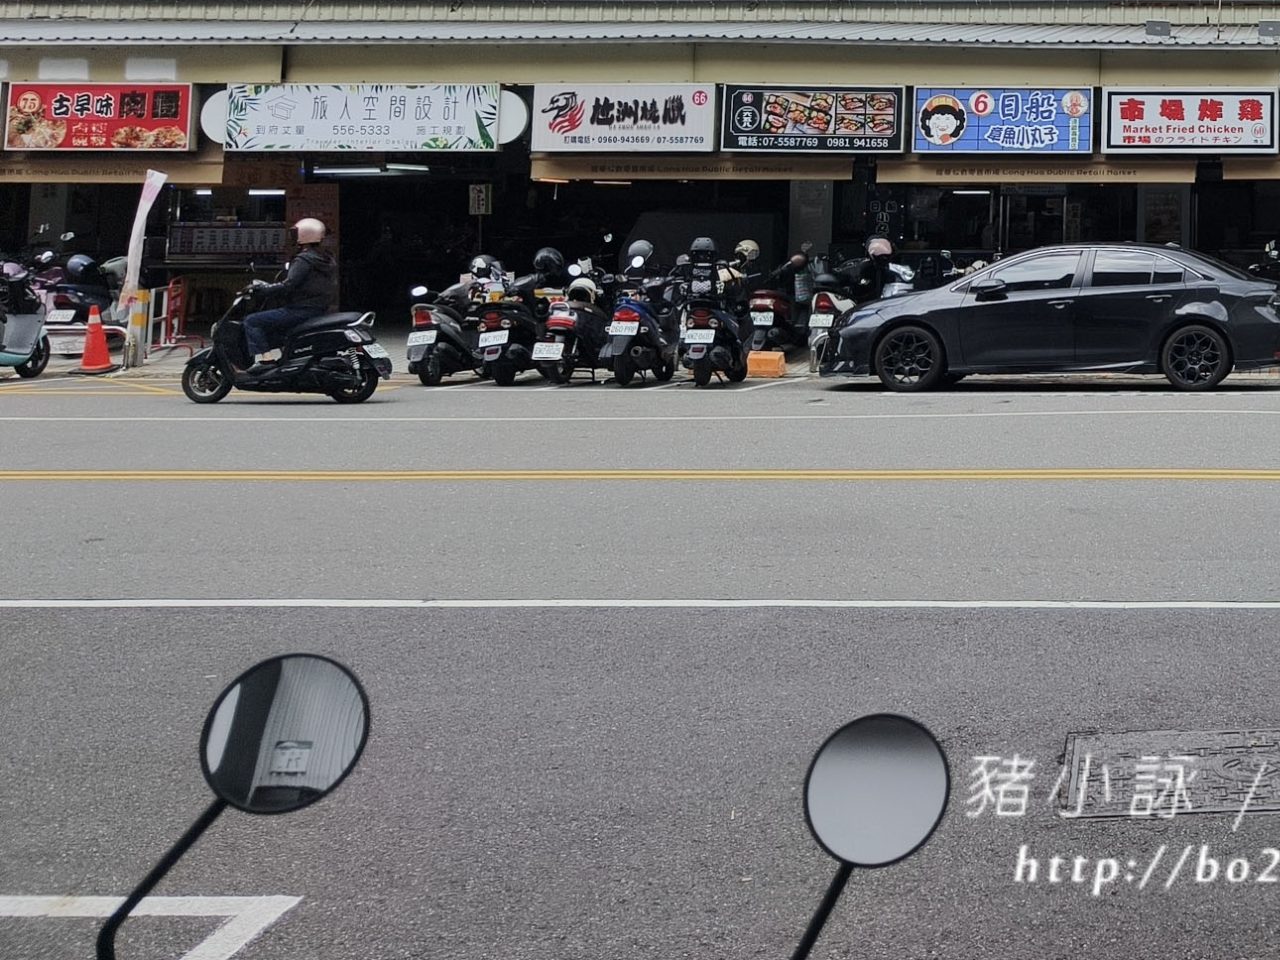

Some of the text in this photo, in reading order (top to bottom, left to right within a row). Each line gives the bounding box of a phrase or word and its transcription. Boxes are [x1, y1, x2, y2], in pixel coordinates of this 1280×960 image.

[694, 93, 706, 104] 66
[974, 94, 988, 113] 6
[311, 96, 459, 121] 旅人空間設計
[1119, 98, 1264, 122] 市場炸雞
[256, 125, 466, 136] 到府丈量 556-5333 施工規劃
[1123, 125, 1244, 134] Market Fried Chicken
[598, 136, 650, 144] 0960-943669
[657, 136, 704, 144] 07-5587769
[987, 126, 1057, 146] 章魚小丸子
[827, 138, 850, 147] 0981
[854, 138, 889, 148] 941658
